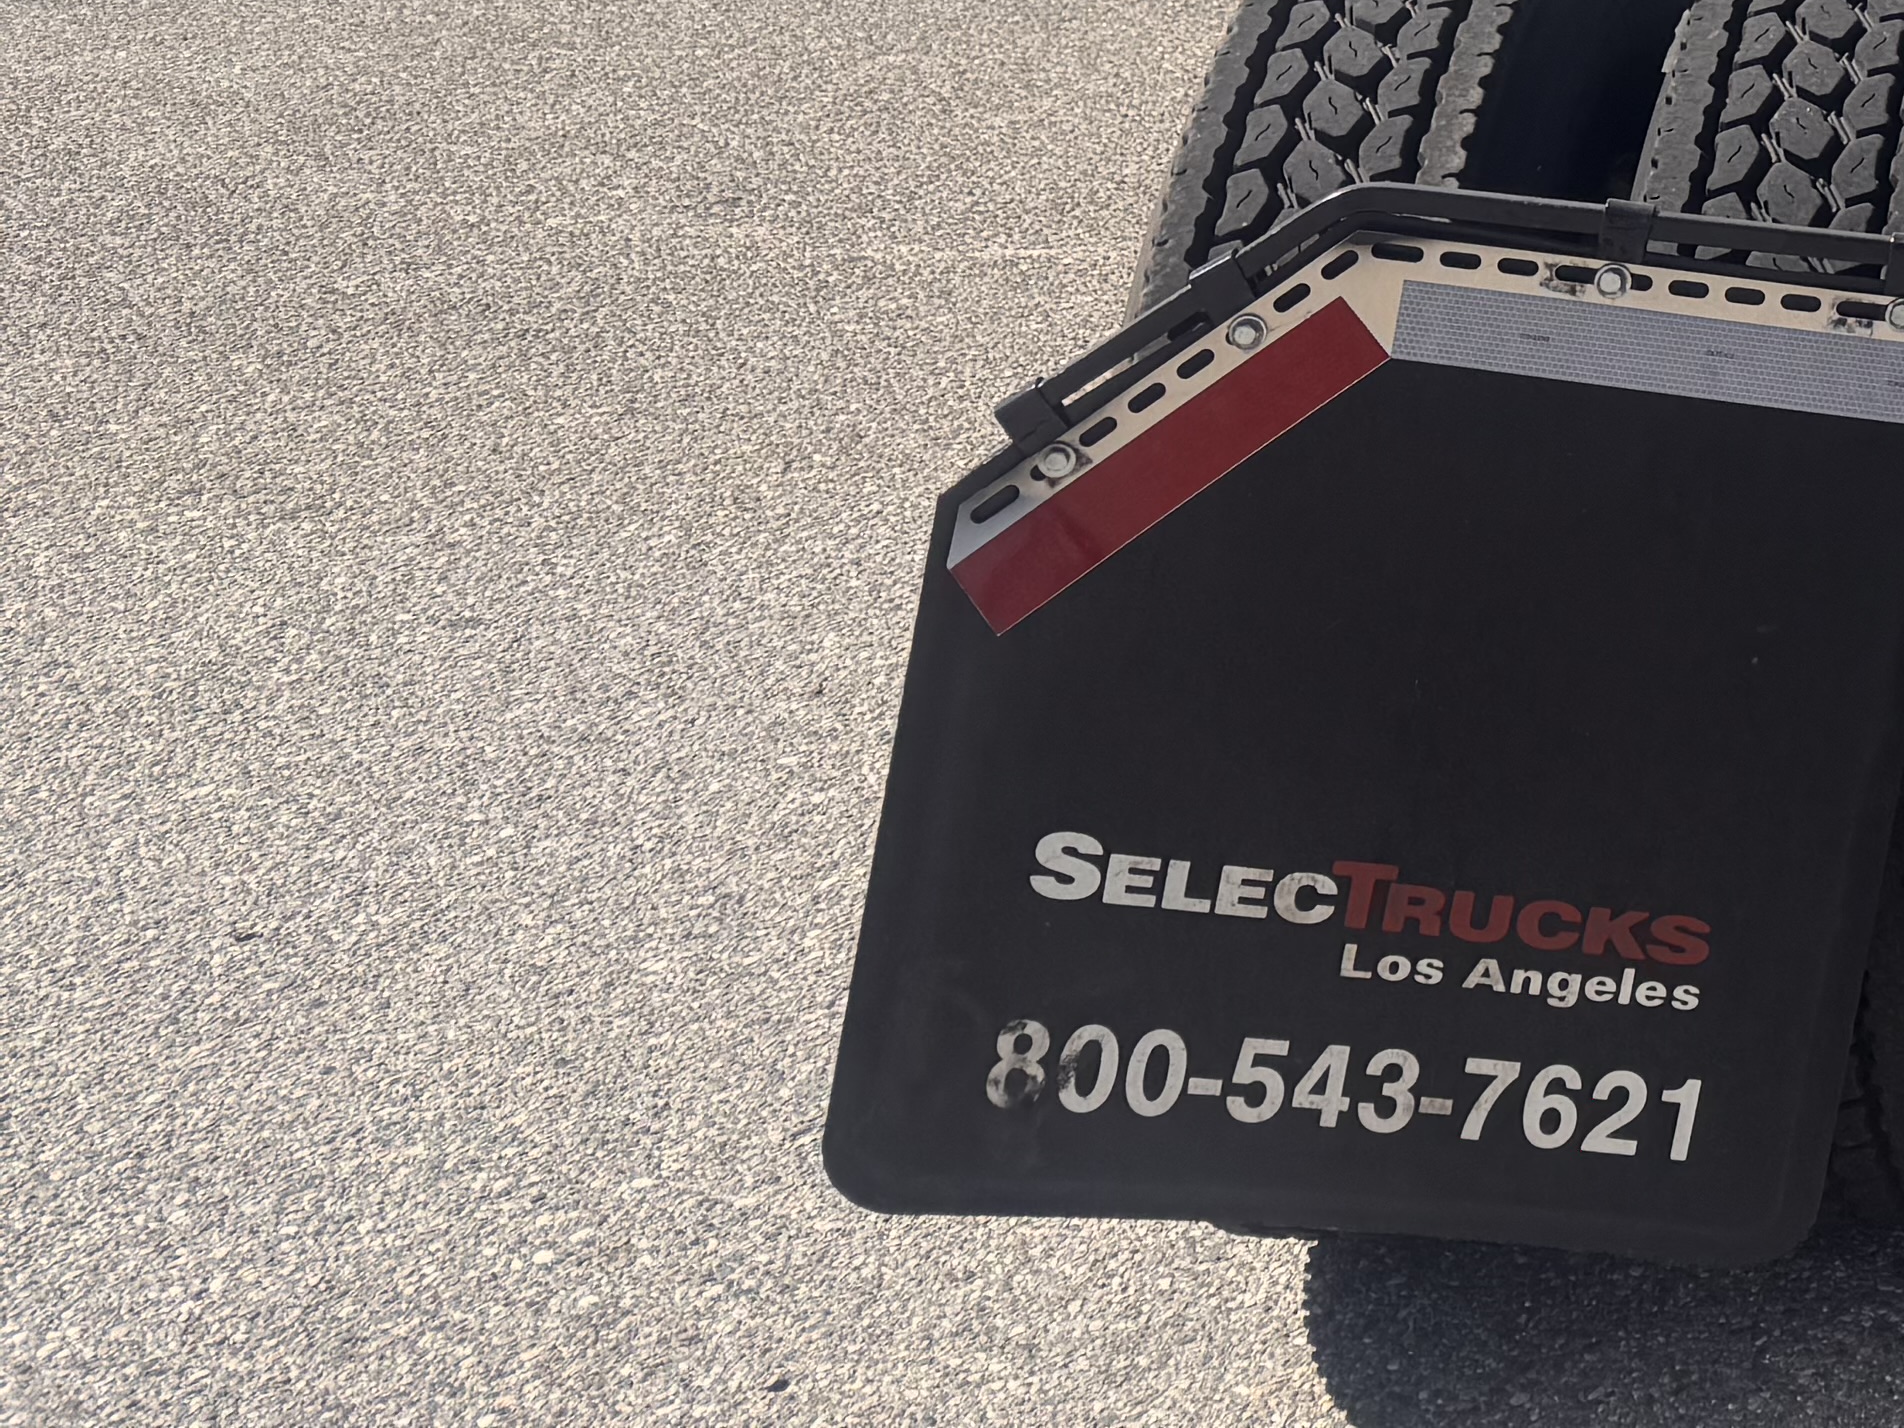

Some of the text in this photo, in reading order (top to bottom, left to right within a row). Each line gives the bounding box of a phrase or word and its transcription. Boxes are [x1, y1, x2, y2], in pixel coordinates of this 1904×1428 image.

[1340, 943, 1701, 1011] Los Angeles
[984, 1017, 1703, 1162] 800-543-7621
